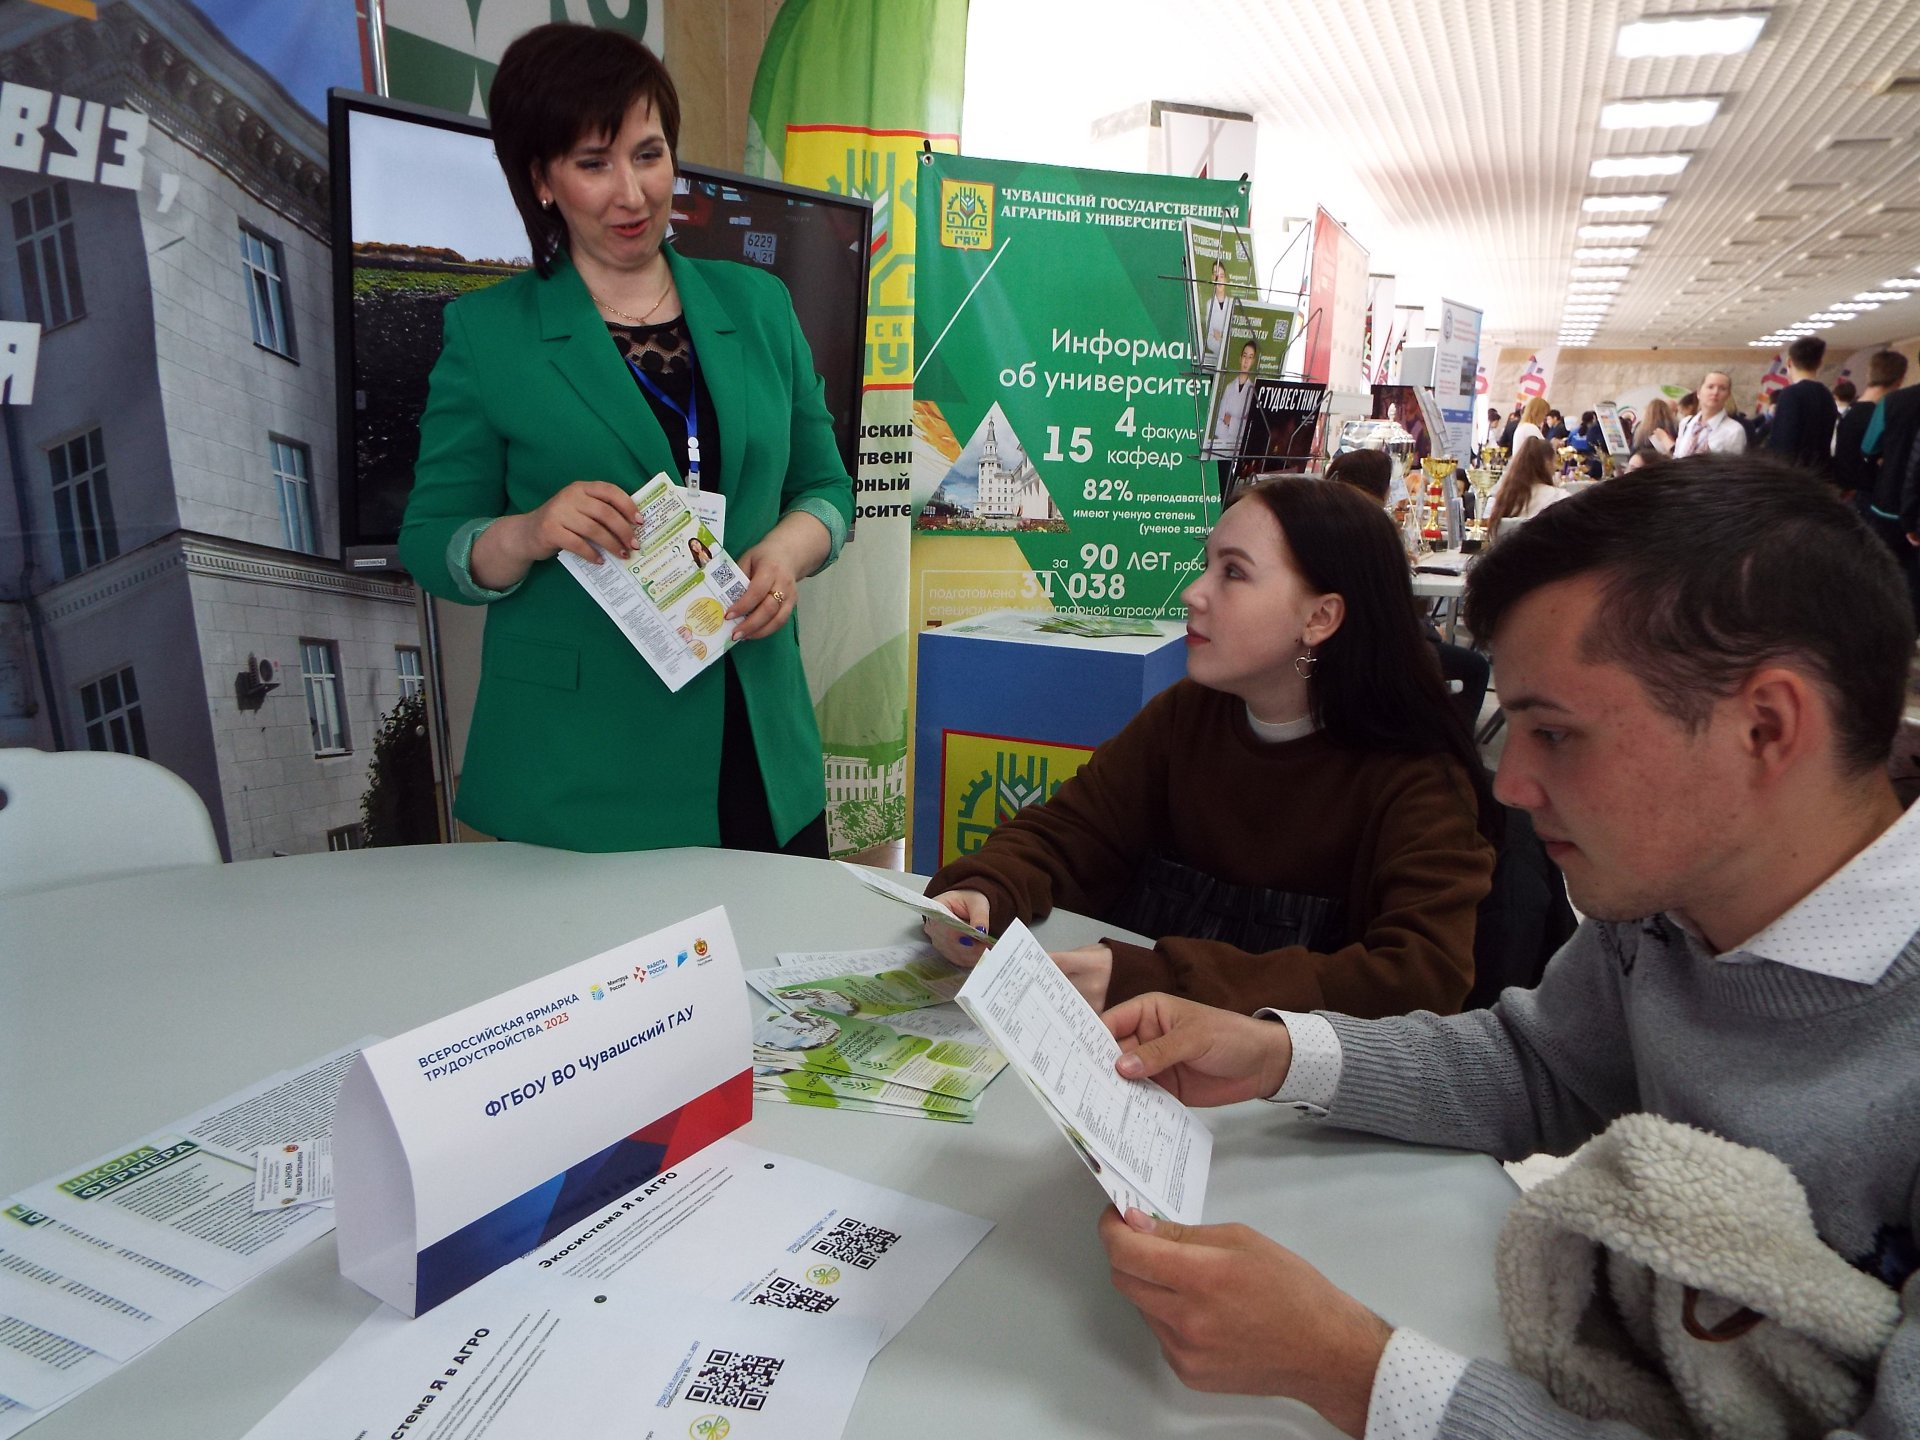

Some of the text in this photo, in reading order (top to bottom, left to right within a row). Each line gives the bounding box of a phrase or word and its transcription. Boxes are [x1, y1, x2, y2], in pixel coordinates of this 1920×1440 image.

[1001, 187, 1240, 219] ЧУВАШСКИЙ ГОСУДАРСТВЕННЫЙ
[1001, 205, 1184, 232] АГРАРНЫЙ УНИВЕРСИТЕТ
[747, 234, 773, 248] 6229
[954, 235, 980, 246] ГАУ
[762, 251, 773, 263] 21
[999, 361, 1037, 388] об
[1256, 386, 1322, 412] СТУДВЕСТНИК
[1114, 406, 1137, 438] 4
[1043, 425, 1183, 471] 15 кафедр
[1082, 478, 1134, 502] 82%
[1073, 509, 1196, 521] имеют ученую степень
[1139, 523, 1181, 536] (ученое
[1052, 558, 1069, 569] за
[1080, 543, 1119, 570] 90
[1127, 551, 1172, 571] лет
[929, 571, 1126, 600] подготовлено 31 038
[1112, 604, 1166, 619] отрасли
[607, 974, 629, 987] Минтруд
[609, 982, 626, 992] России
[418, 993, 580, 1068] ВСЕРОССИЙСКАЯ ЯРМАРКА
[423, 1012, 570, 1082] ТРУДОУСТРОЙСТВА 2023
[485, 1005, 695, 1117] ФГБОУ ВО Чувашский ГАУ
[64, 1149, 155, 1190] ШКОЛА
[81, 1144, 194, 1196] ФЕРМЕРА
[538, 1210, 624, 1268] Экосистема
[620, 1202, 635, 1211] Я
[643, 1171, 678, 1196] АГРО
[391, 1327, 490, 1440] стема Я в АГРО
